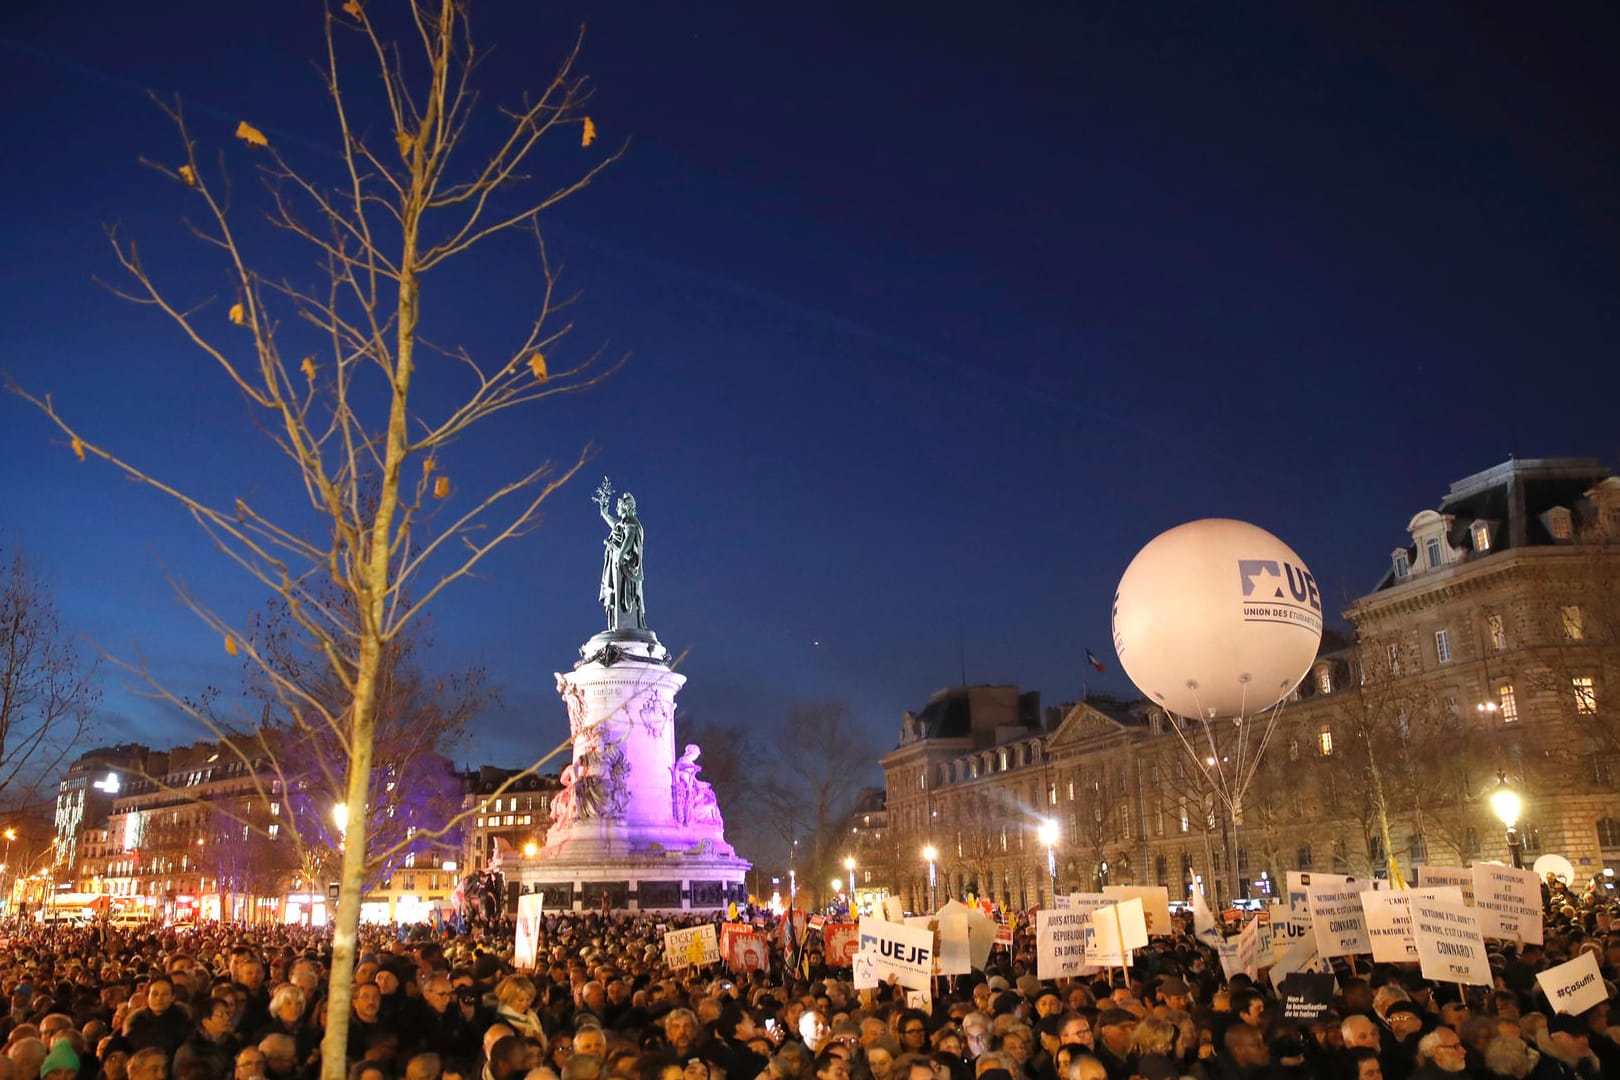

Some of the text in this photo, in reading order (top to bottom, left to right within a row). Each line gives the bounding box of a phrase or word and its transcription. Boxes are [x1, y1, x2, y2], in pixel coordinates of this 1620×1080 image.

[1244, 608, 1271, 617] UNION
[1273, 609, 1288, 618] DES
[1064, 912, 1090, 926] ATTAQUÉS
[1330, 918, 1358, 933] CONNARD
[880, 939, 929, 965] UEJF
[1054, 946, 1063, 957] EN
[1436, 941, 1470, 959] CONNARD
[1556, 973, 1596, 999] #ÇaSuffit
[1287, 995, 1300, 1003] Non
[1285, 1002, 1328, 1010] la banalisation
[1284, 1010, 1293, 1018] de
[1293, 1010, 1299, 1018] la
